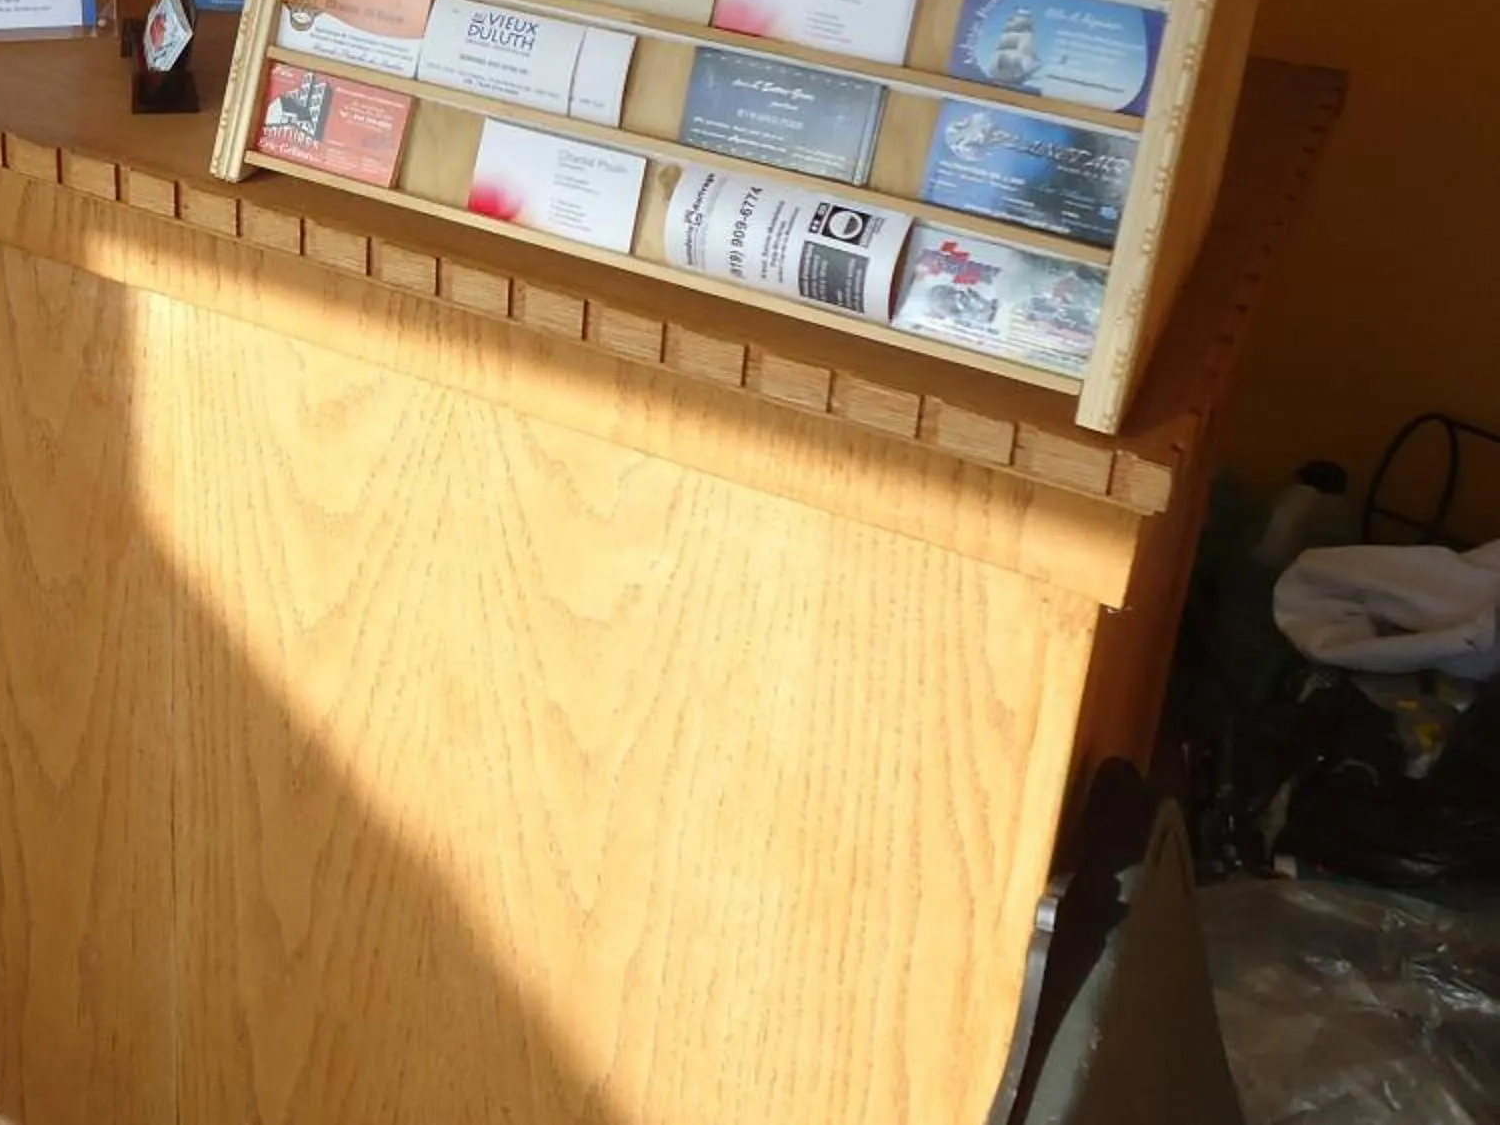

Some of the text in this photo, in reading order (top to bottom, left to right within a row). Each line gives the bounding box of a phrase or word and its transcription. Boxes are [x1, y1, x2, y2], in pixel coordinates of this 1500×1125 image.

[488, 11, 540, 36] VIEUX
[467, 24, 536, 51] DULUTH
[732, 186, 763, 246] 909-6774
